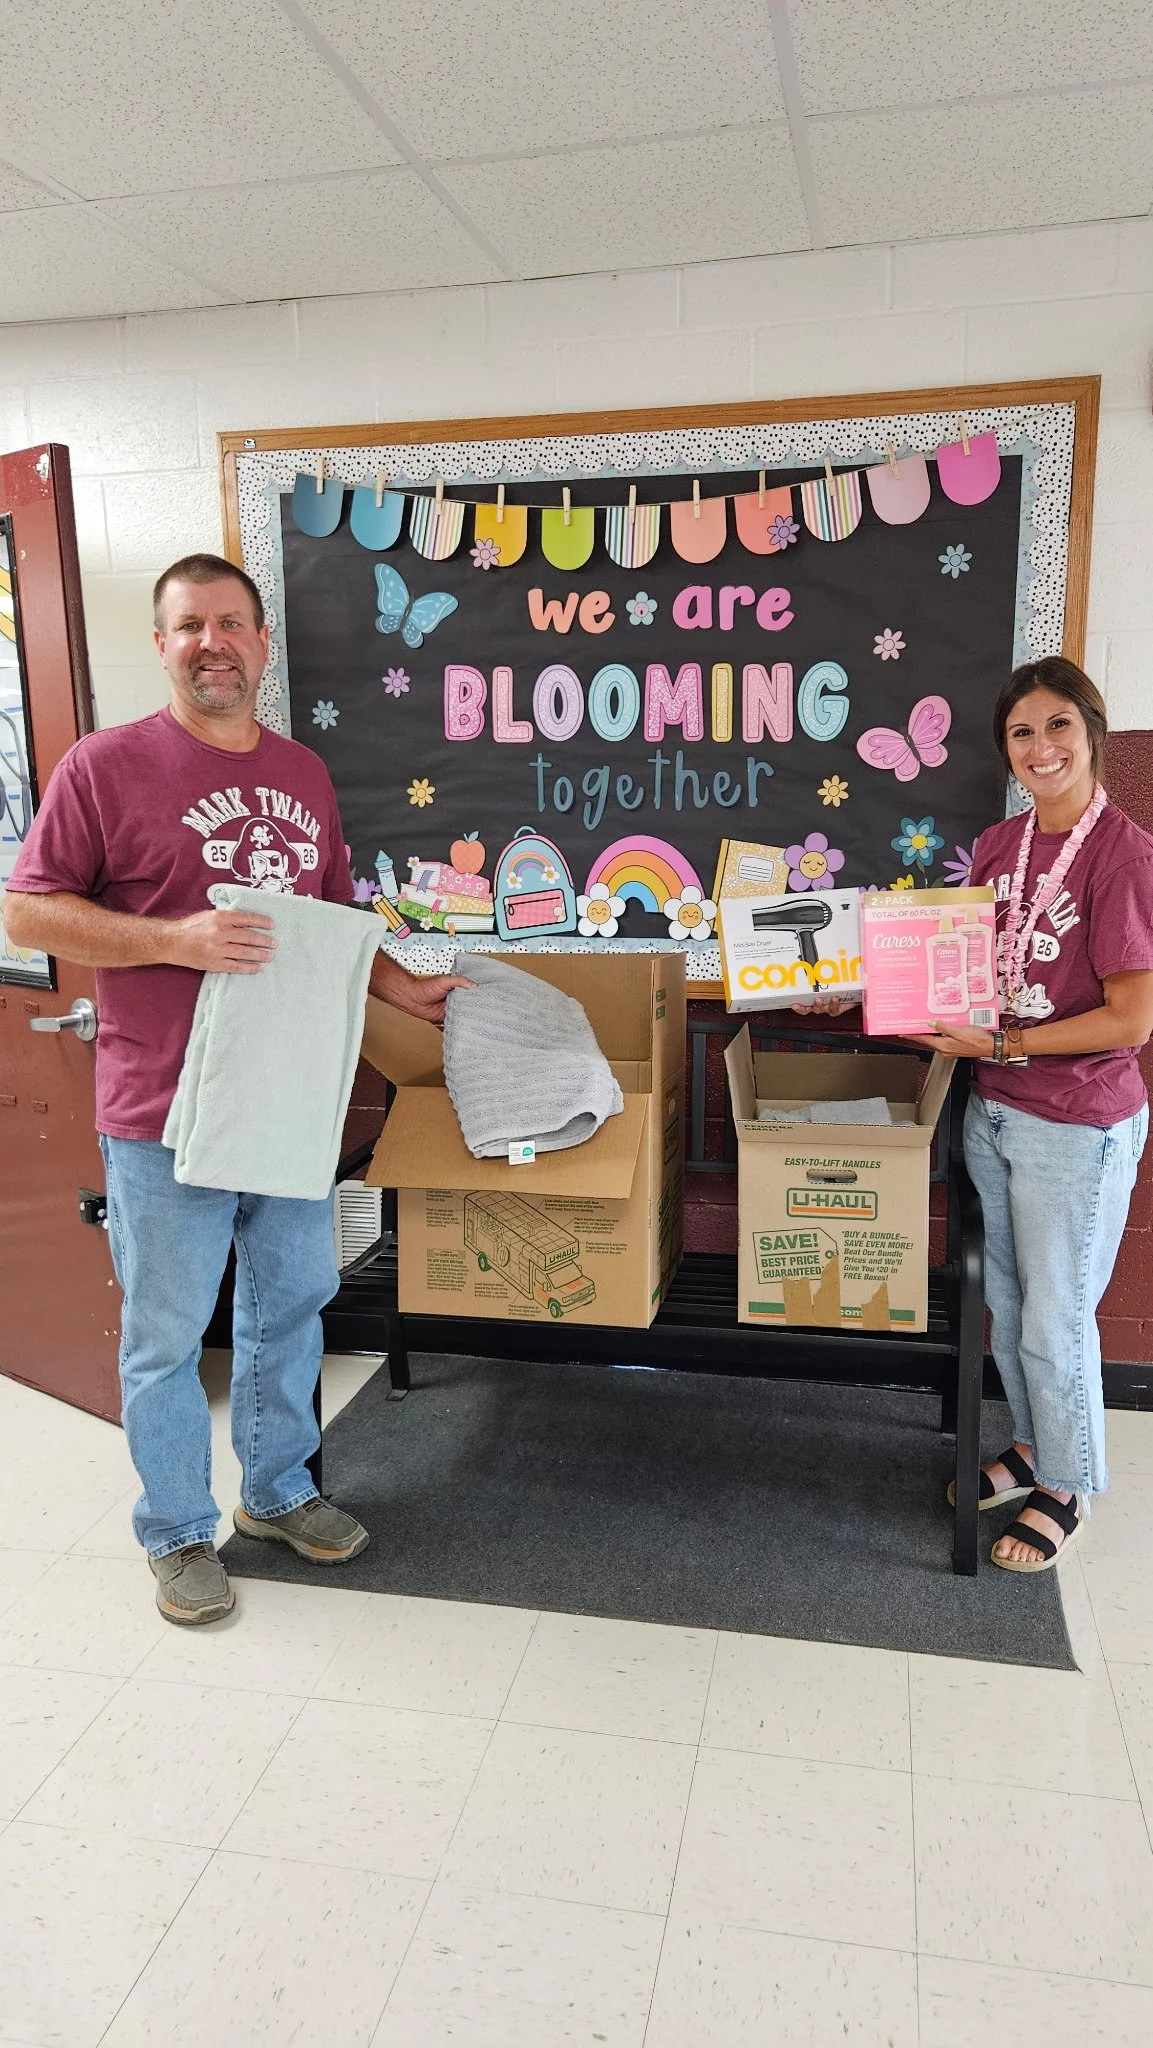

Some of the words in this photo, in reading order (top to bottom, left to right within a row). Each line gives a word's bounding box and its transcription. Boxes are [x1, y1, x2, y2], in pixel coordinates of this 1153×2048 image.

[527, 587, 616, 635] we
[672, 584, 795, 632] are
[444, 661, 850, 744] BLOOMING
[529, 749, 775, 831] together
[181, 786, 251, 839] MARK
[255, 786, 321, 842] TWAIN
[210, 845, 228, 862] 25
[303, 848, 315, 864] 26
[872, 933, 921, 949] Caress
[1037, 938, 1053, 957] 26
[738, 948, 863, 991] conair
[784, 1157, 841, 1168] EASY-TO-LIFT
[842, 1159, 881, 1169] HANDLES
[792, 1192, 873, 1209] U-HAUL
[759, 1233, 819, 1251] SAVE!
[861, 1231, 867, 1239] A
[843, 1247, 861, 1256] Beat
[862, 1248, 876, 1257] Our
[877, 1249, 903, 1258] Bundle
[844, 1239, 864, 1248] SAVE
[865, 1240, 886, 1248] EVEN
[887, 1241, 914, 1250] MORE!
[549, 1246, 577, 1264] U-HAUL
[761, 1257, 786, 1268] BEST
[789, 1254, 820, 1266] PRICE
[843, 1256, 867, 1264] Prices
[867, 1257, 883, 1265] and
[884, 1258, 903, 1266] We'll
[843, 1264, 860, 1272] Give
[861, 1265, 875, 1273] You
[890, 1266, 898, 1274] in
[843, 1272, 863, 1280] FREE
[863, 1273, 889, 1281] Boxes!
